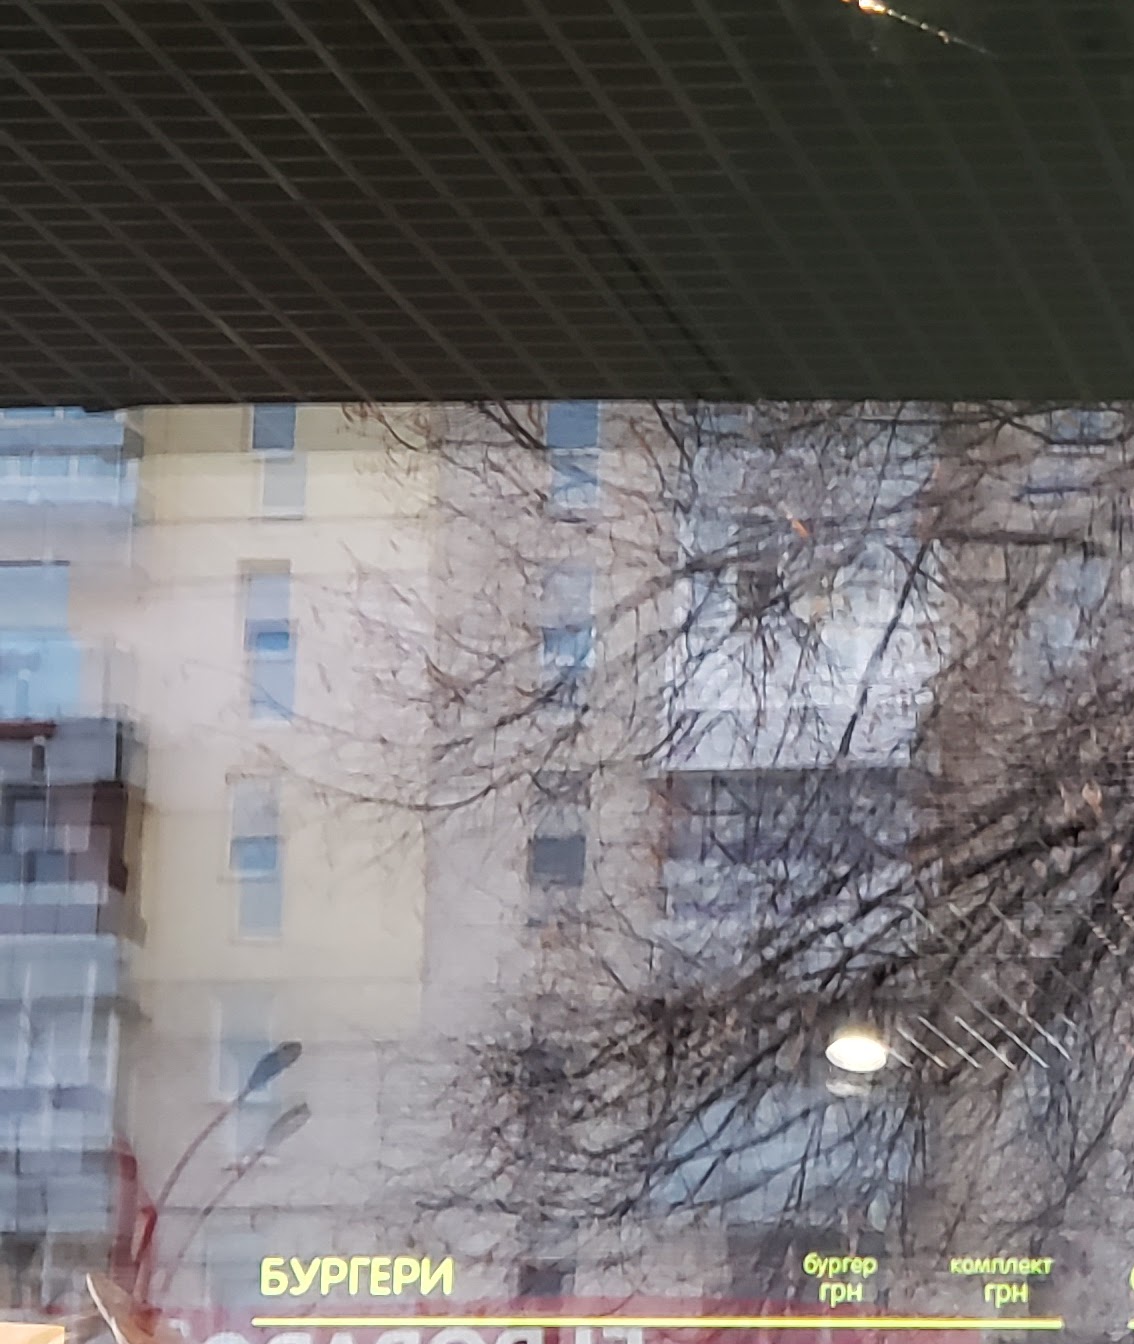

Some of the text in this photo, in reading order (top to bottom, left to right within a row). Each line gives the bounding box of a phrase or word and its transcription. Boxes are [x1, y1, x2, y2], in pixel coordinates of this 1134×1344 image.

[259, 1256, 455, 1297] БУРГЕРИ
[803, 1252, 878, 1278] бургер
[950, 1255, 1052, 1278] комплект
[819, 1280, 861, 1304] грн
[985, 1281, 1028, 1307] грн
